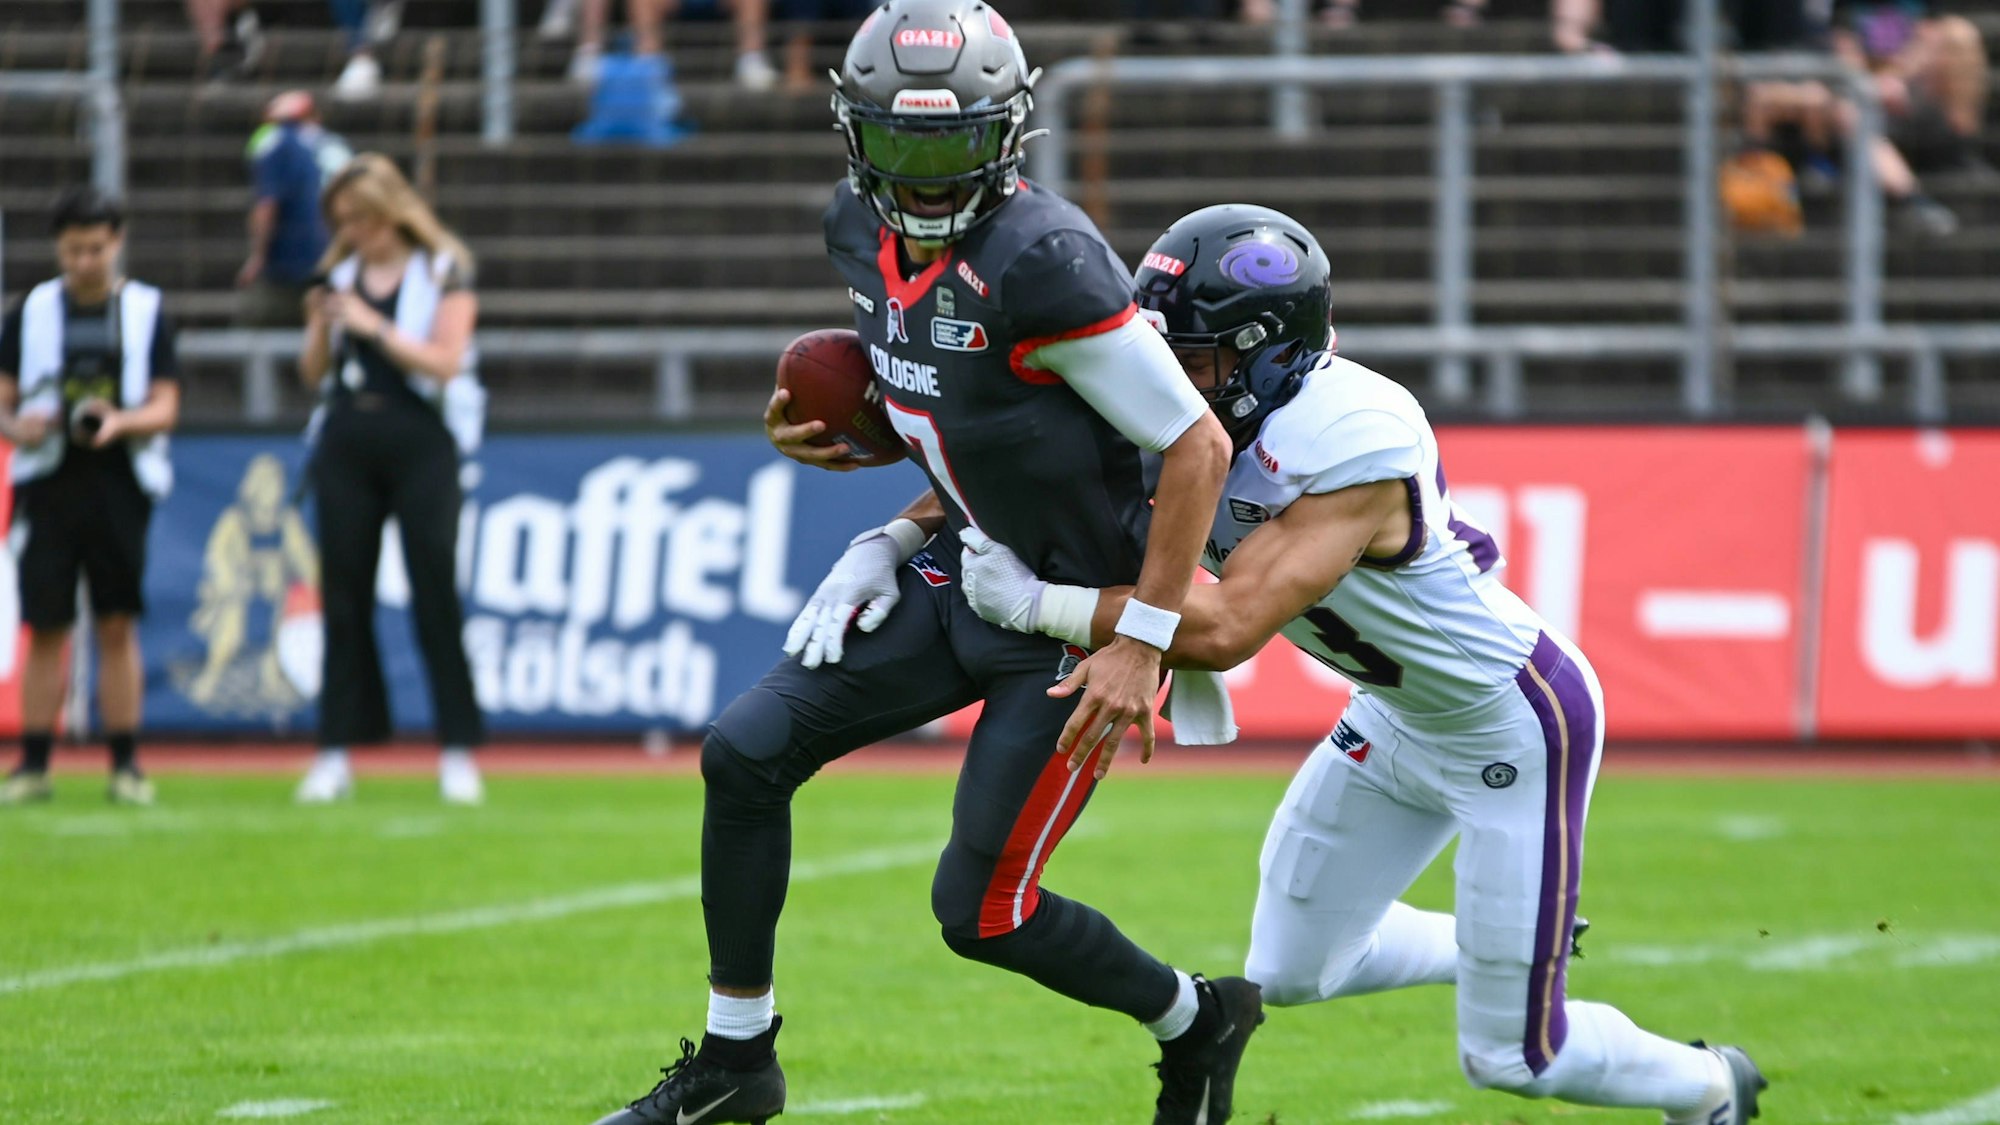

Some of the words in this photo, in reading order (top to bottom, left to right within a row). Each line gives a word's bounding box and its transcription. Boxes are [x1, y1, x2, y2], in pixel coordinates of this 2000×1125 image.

[900, 29, 954, 48] GAZI
[957, 261, 985, 296] GAZI
[1144, 252, 1181, 276] GAZI
[870, 343, 942, 398] COLOGNE
[884, 395, 984, 535] 7
[456, 456, 803, 632] affel
